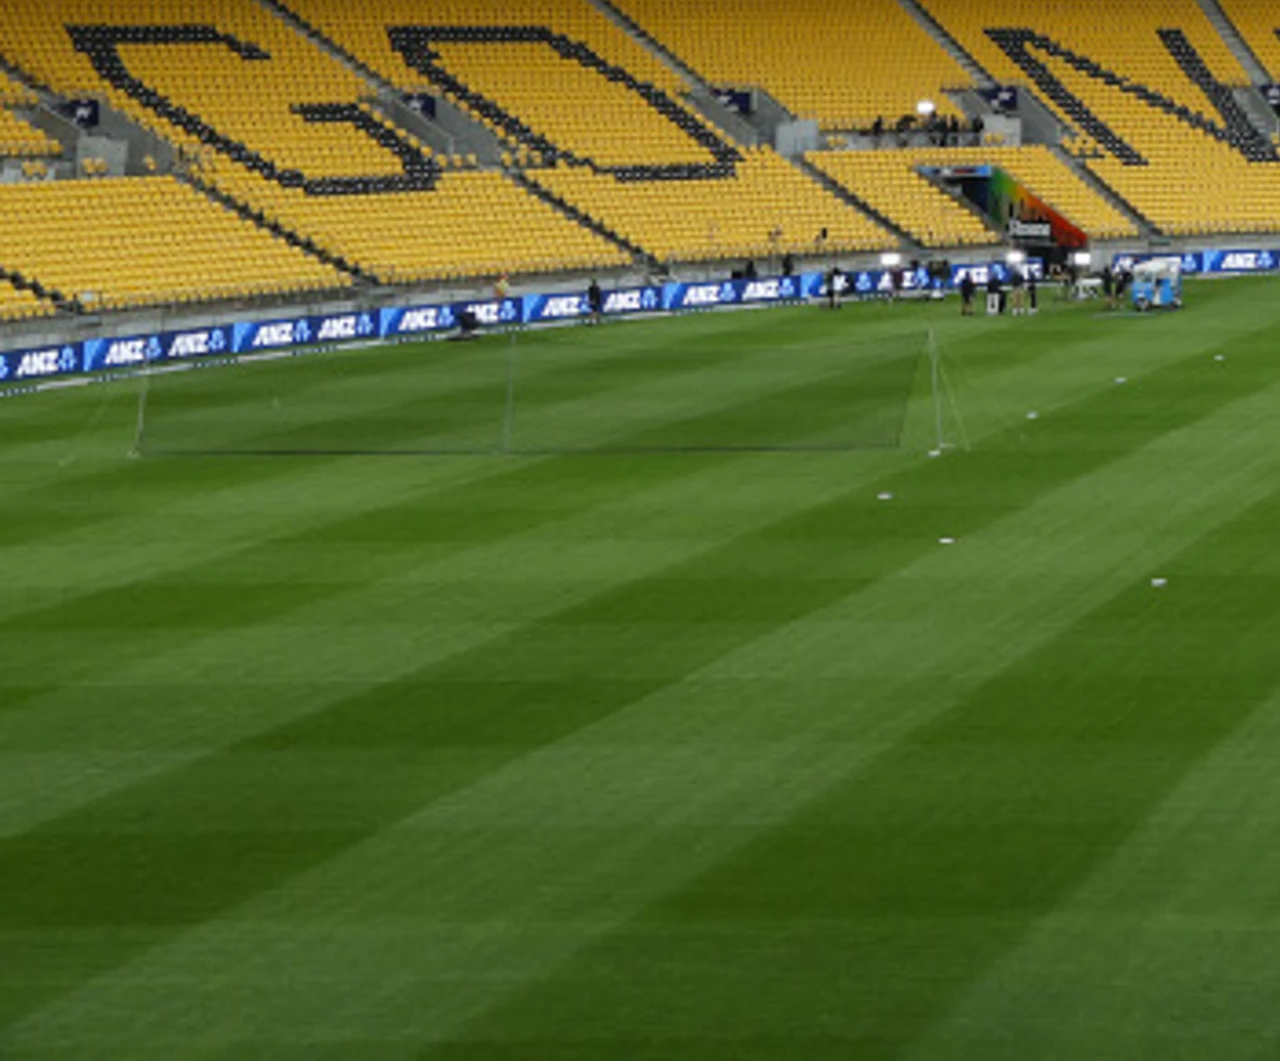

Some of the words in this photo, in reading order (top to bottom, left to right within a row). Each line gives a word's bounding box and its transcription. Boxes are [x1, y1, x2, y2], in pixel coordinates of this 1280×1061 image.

[64, 24, 744, 197] GO
[1221, 253, 1256, 269] ANZ
[683, 285, 720, 305] ANZ
[743, 280, 779, 299] ANZ
[542, 296, 580, 316] ANZ
[604, 291, 640, 311] ANZ
[318, 316, 356, 338] ANZ
[399, 308, 437, 330] ANZ
[169, 333, 208, 356] ANZ
[253, 323, 293, 345] ANZ
[17, 351, 58, 375] ANZ
[105, 340, 144, 364] ANZ
